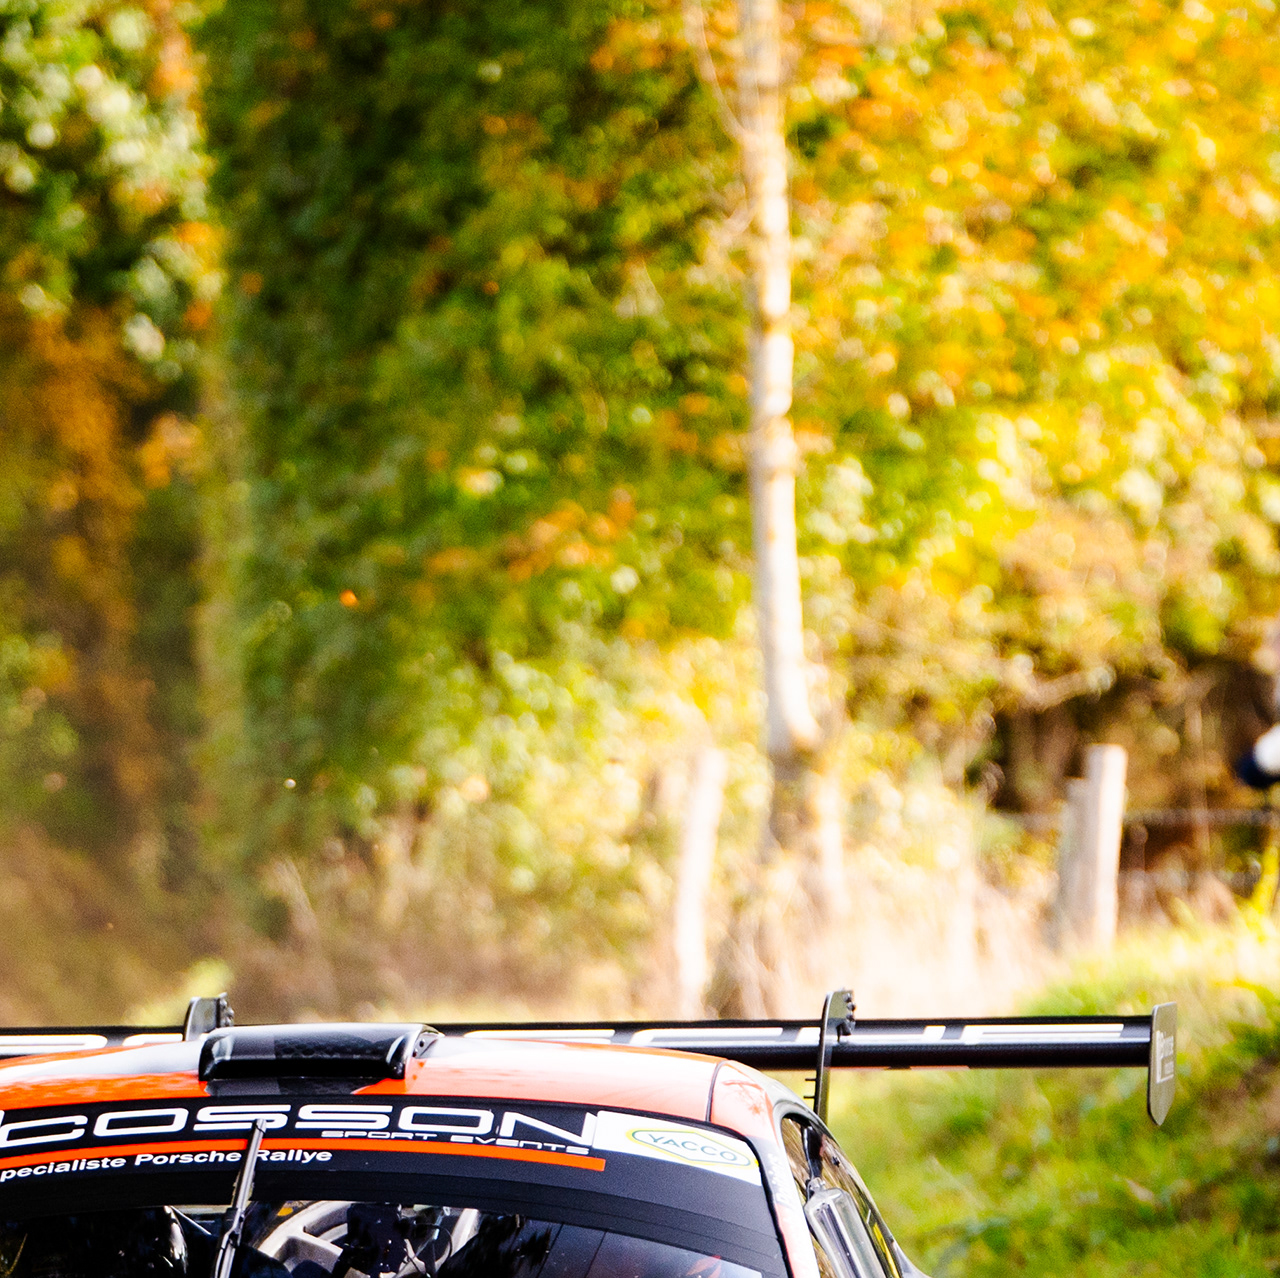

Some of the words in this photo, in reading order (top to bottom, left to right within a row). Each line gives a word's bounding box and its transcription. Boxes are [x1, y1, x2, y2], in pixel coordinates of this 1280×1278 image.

[321, 1130, 443, 1141] SPORT
[450, 1135, 590, 1155] EVENTS
[648, 1133, 738, 1161] YACCO
[135, 1149, 241, 1167] Porsche
[255, 1149, 332, 1165] Rallye
